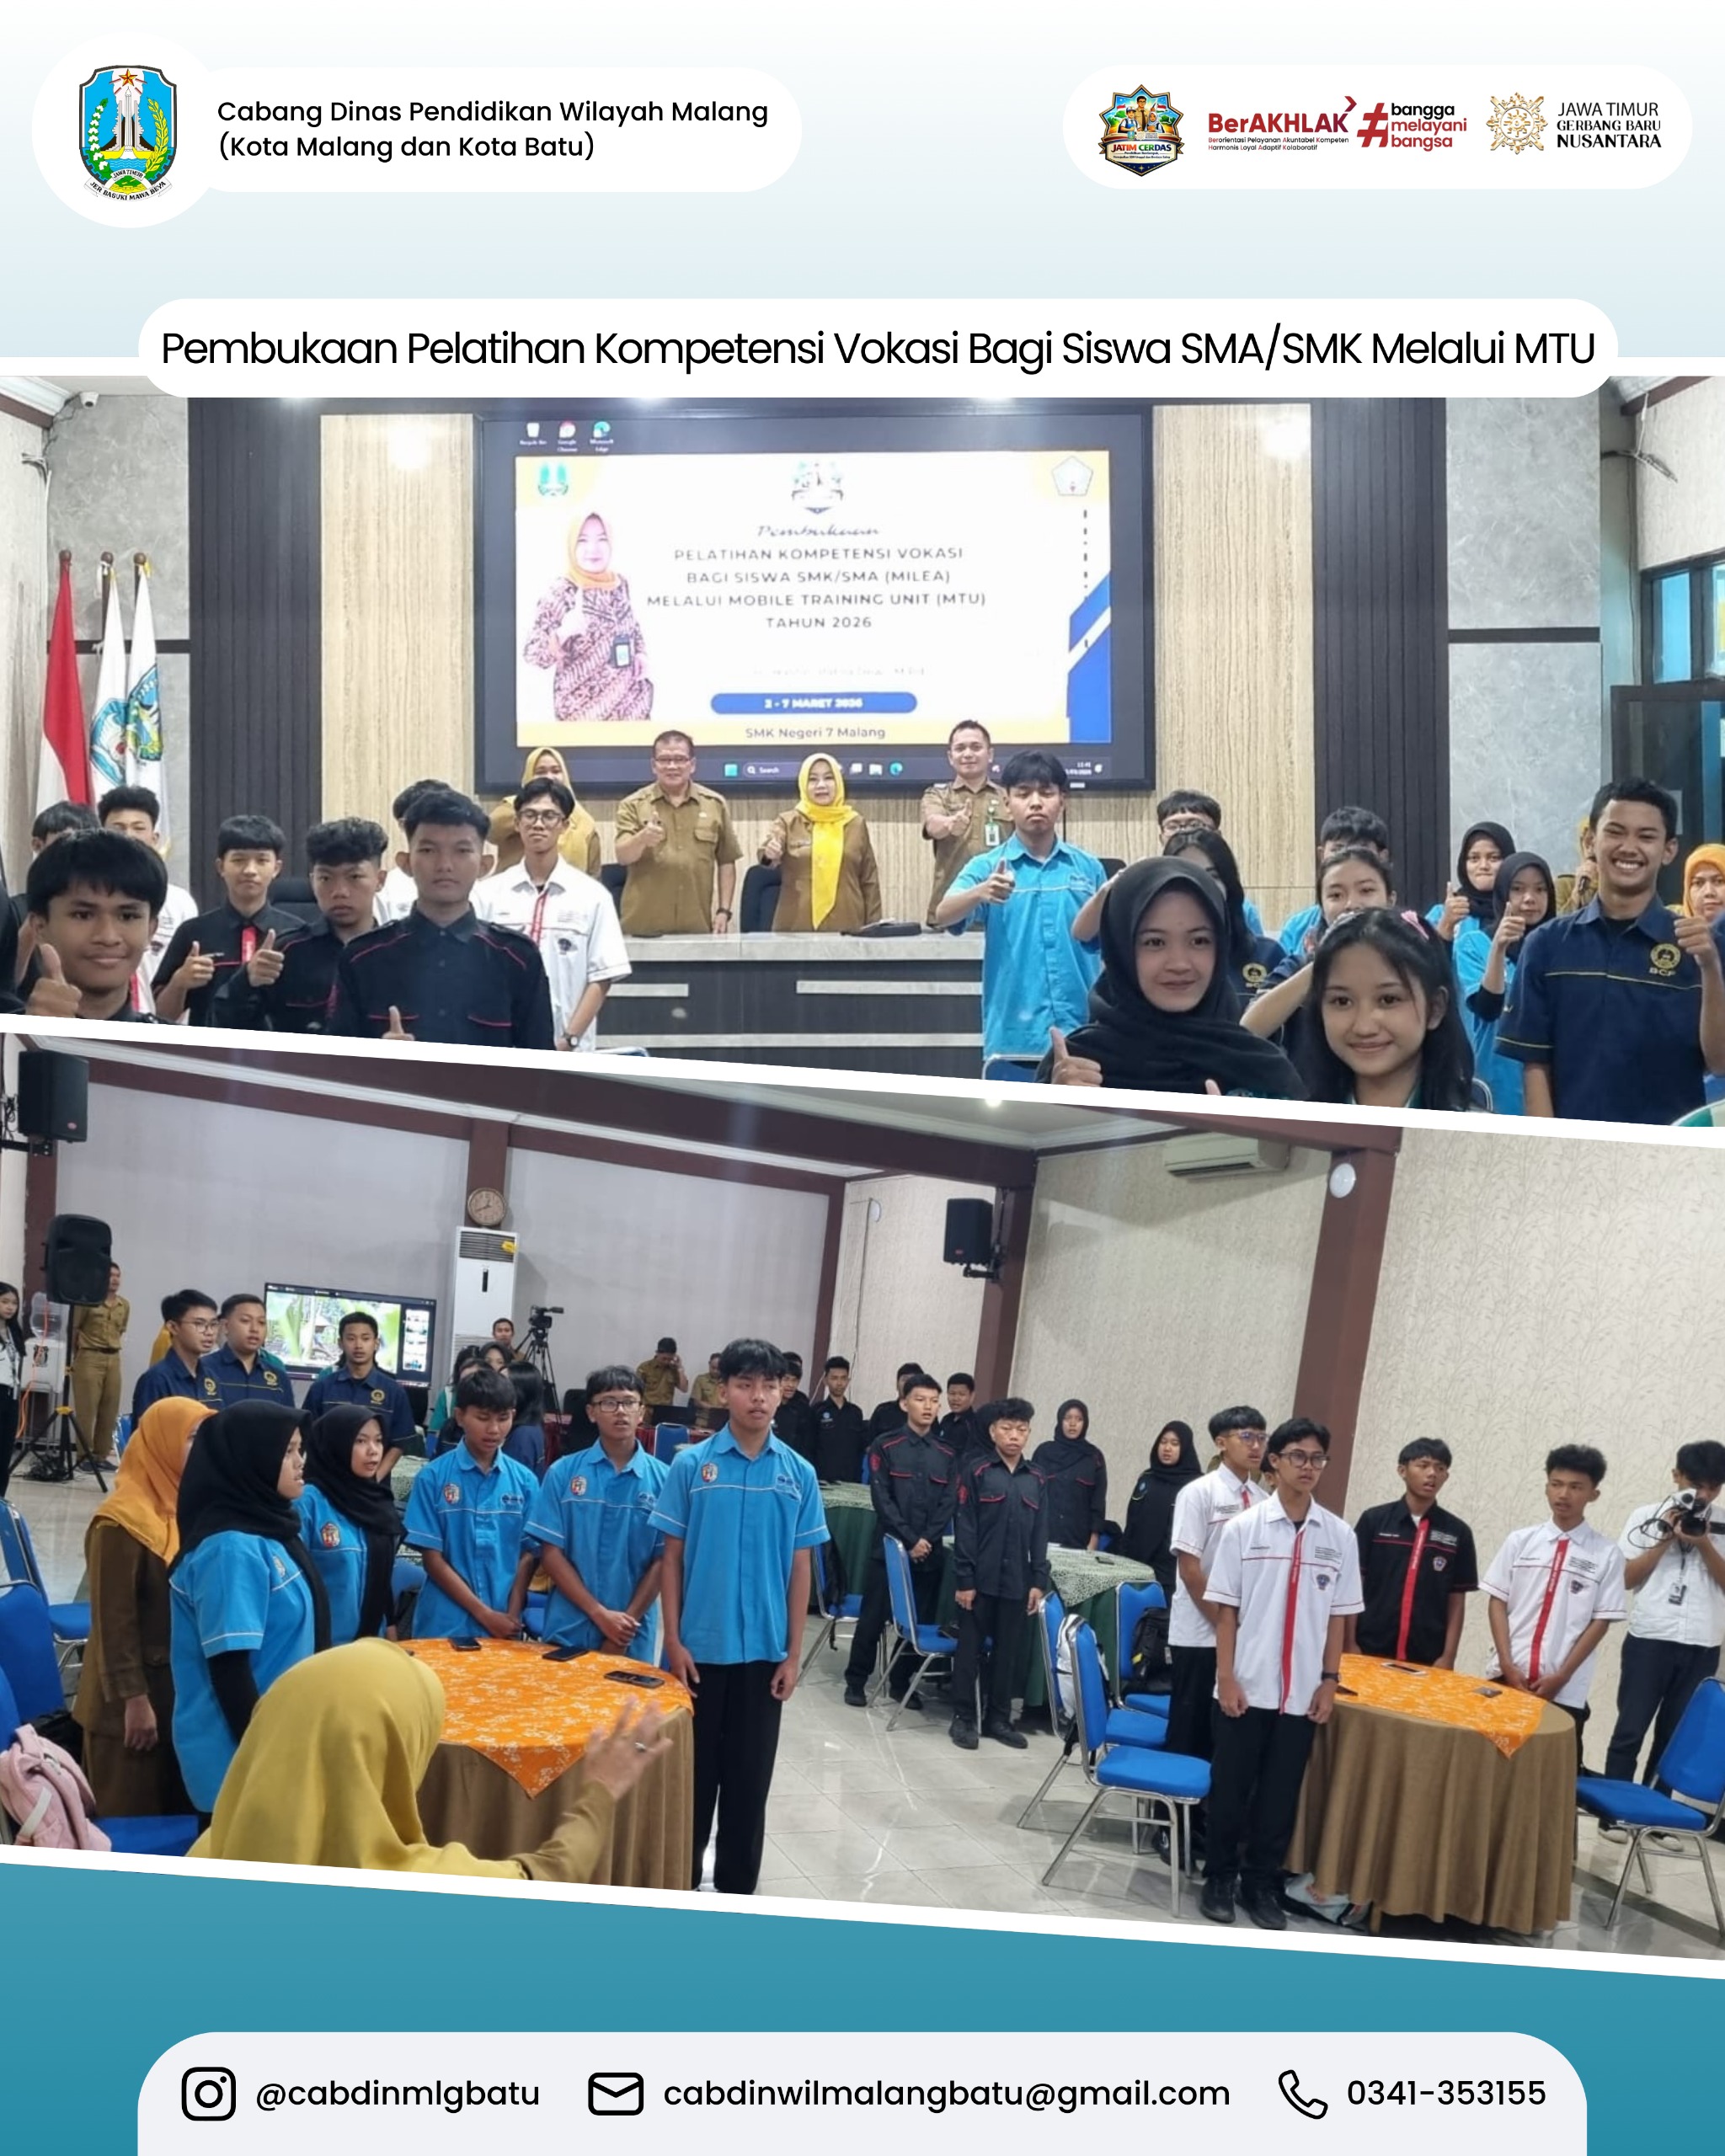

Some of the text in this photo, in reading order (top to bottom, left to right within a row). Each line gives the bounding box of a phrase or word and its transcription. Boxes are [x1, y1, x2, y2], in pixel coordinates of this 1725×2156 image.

[674, 547, 963, 561] PELATIHAN KOMPETENSI VOKASI
[686, 570, 951, 584] BAGI SISWA SMK/SMA (MILEA)
[647, 592, 986, 606] MELALUI MOBILE TRAINING UNIT (MTU)
[766, 616, 873, 628] TAHUN 2026
[745, 727, 887, 739] SMK Negeri 7 Malang
